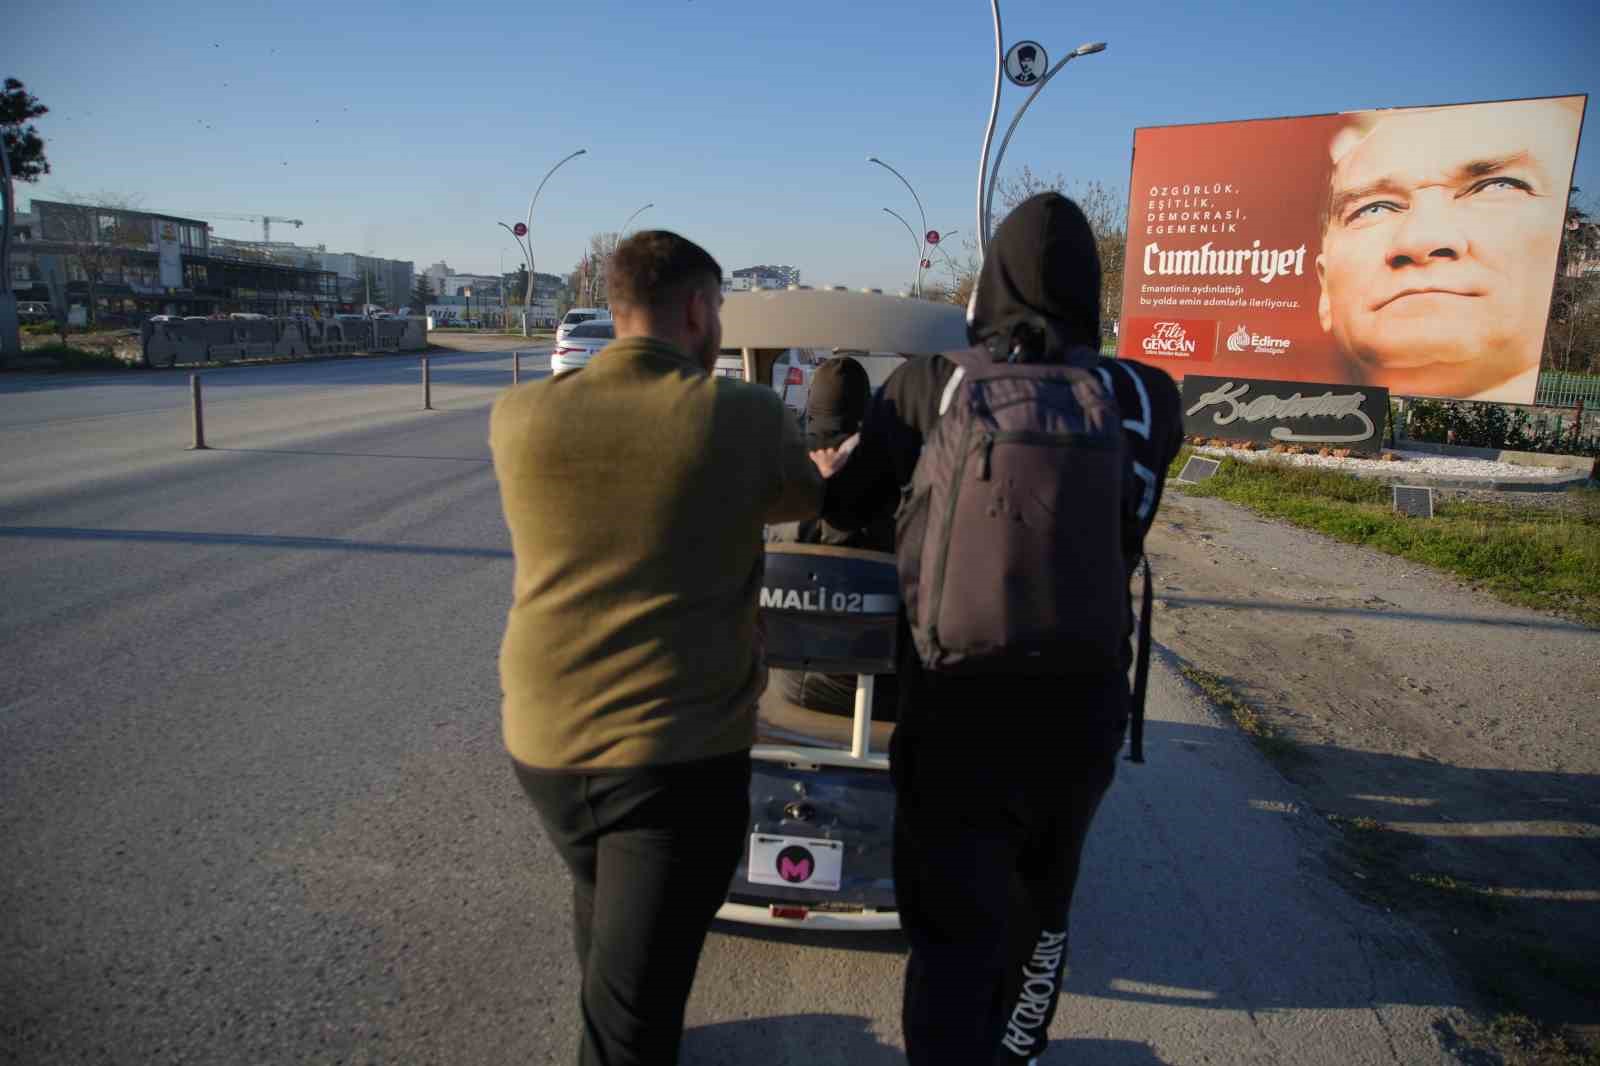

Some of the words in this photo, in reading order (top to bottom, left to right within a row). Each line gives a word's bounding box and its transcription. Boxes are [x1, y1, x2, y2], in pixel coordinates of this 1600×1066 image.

[1150, 183, 1239, 196] ÖZGÜRLÜK,
[1148, 198, 1215, 210] EŞİTLİK,
[1147, 208, 1247, 222] DEMOKRASİ,
[1146, 223, 1237, 235] EGEMENLİK
[1143, 240, 1307, 284] Cumhuriyet
[1141, 284, 1190, 293] Emanetinin
[1152, 297, 1177, 307] yolda
[759, 586, 826, 611] MALİ
[831, 592, 862, 613] 02
[782, 856, 809, 881] M
